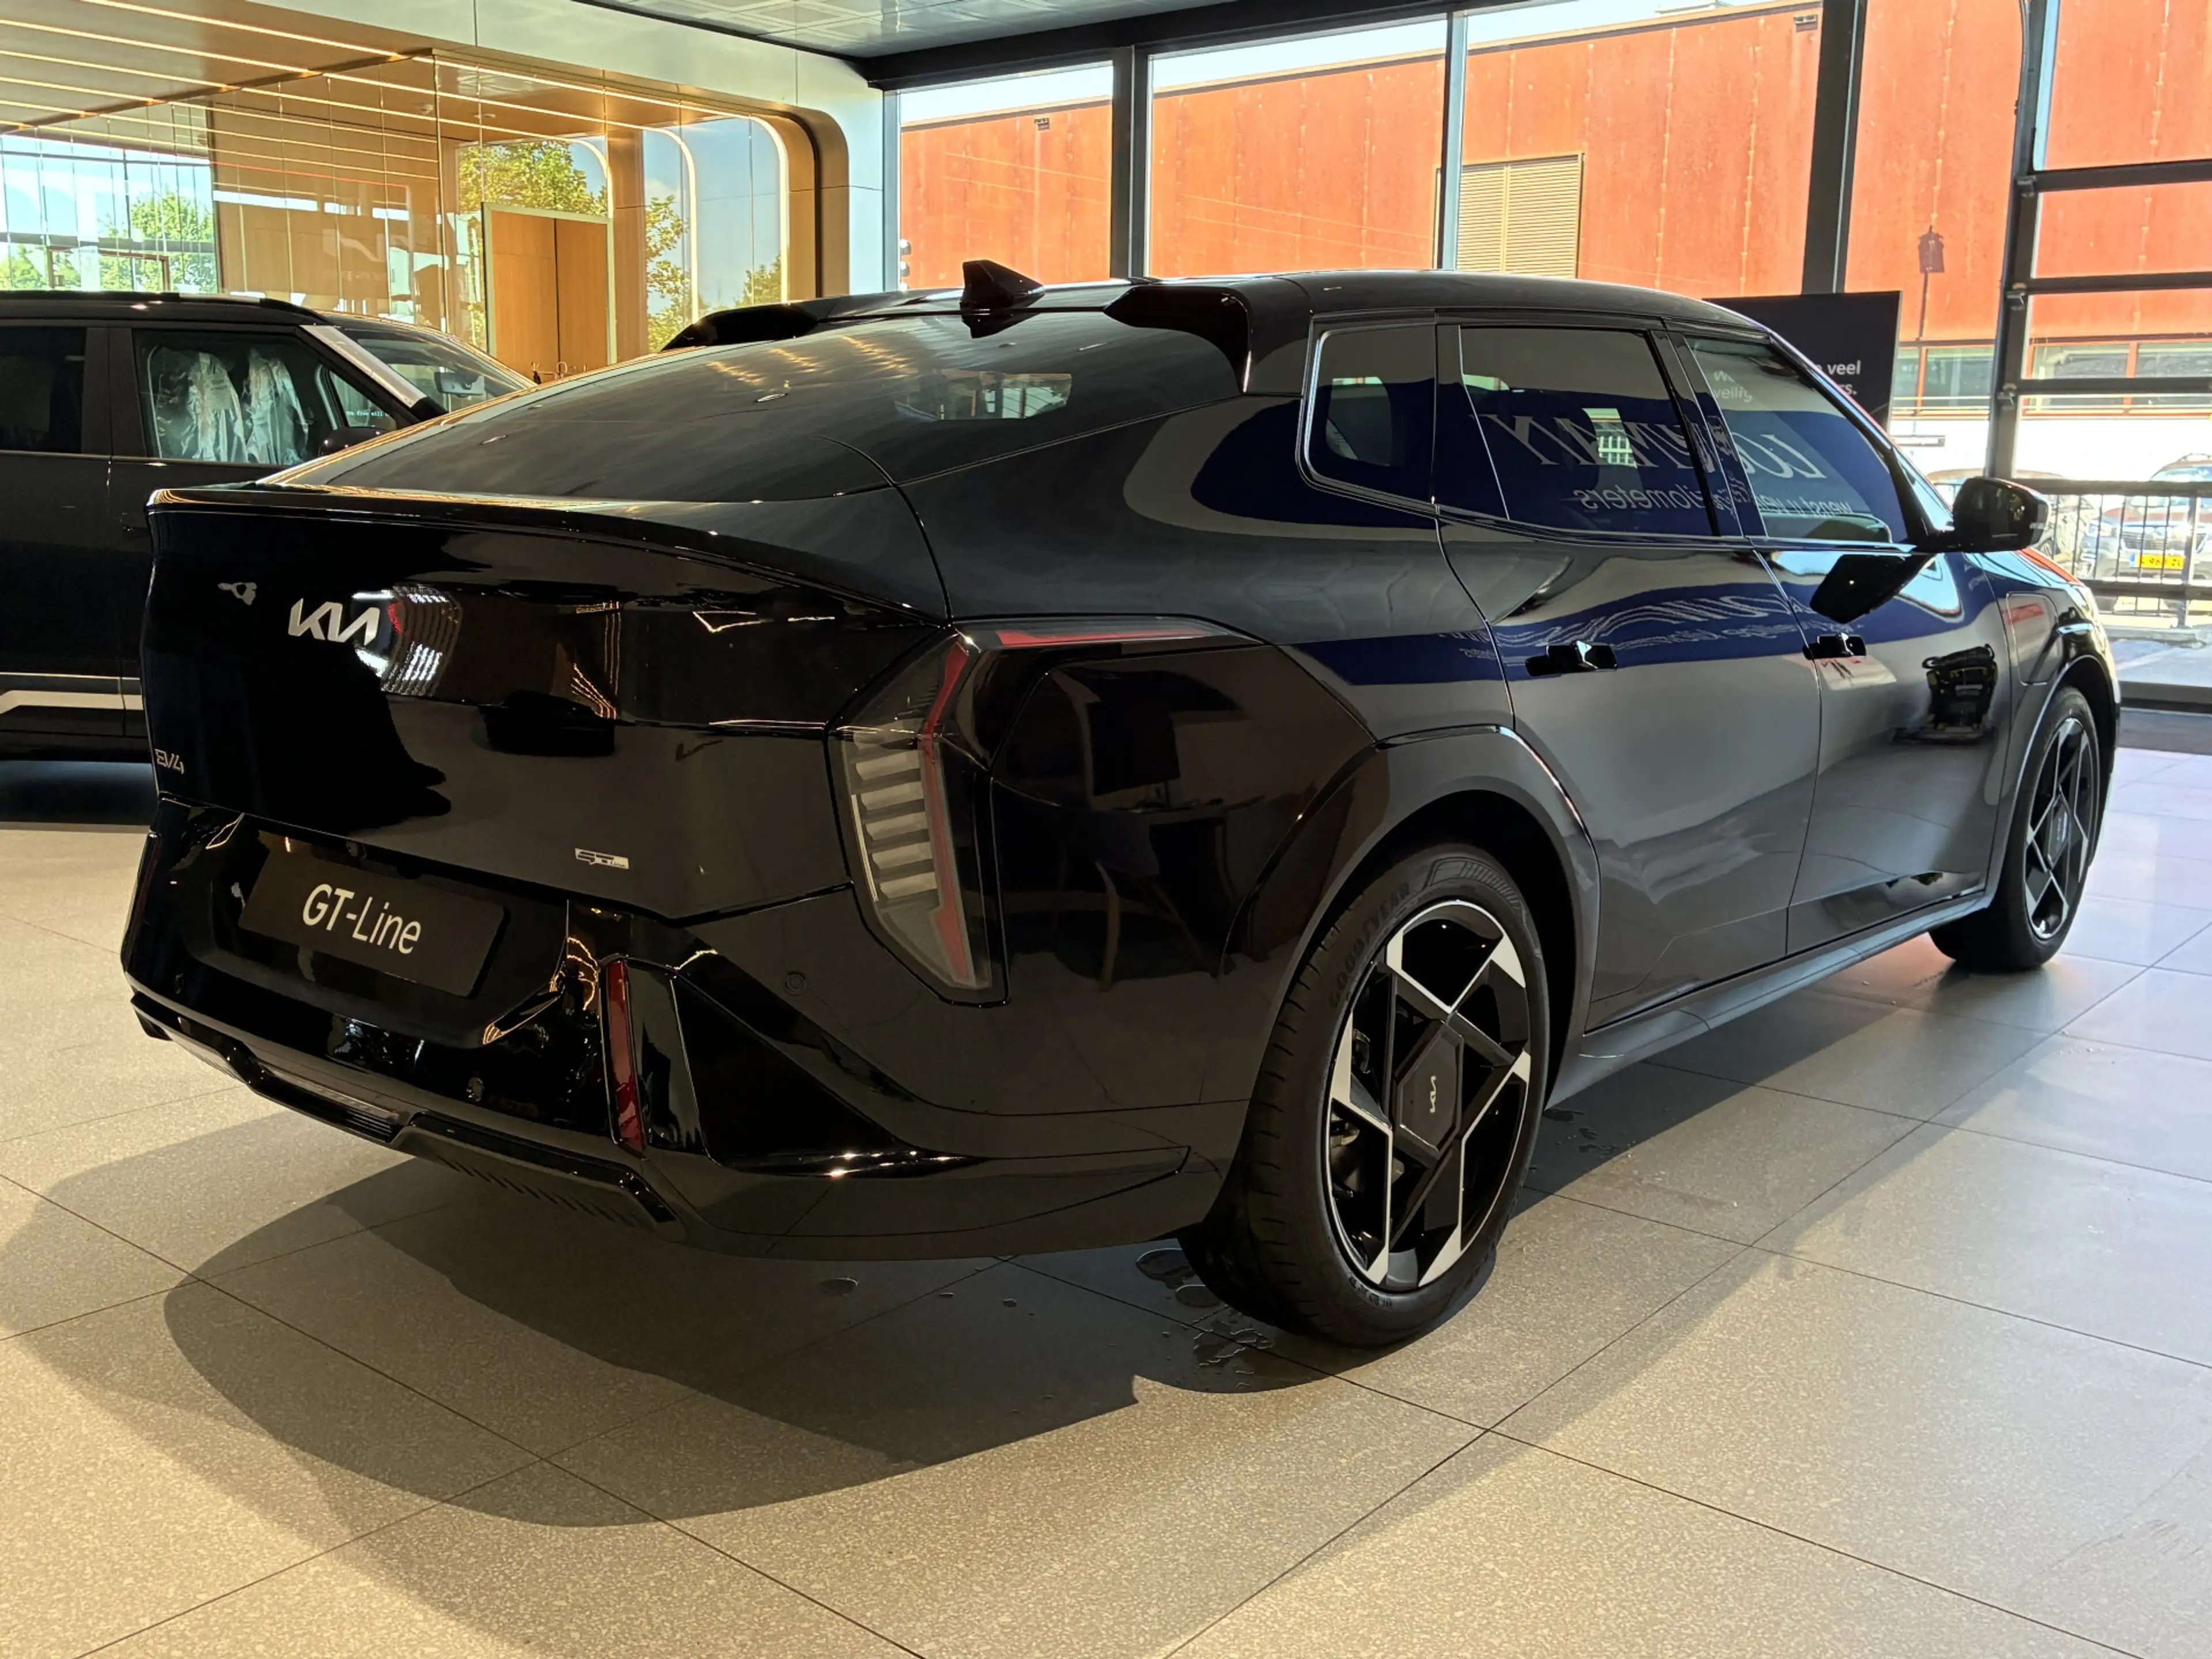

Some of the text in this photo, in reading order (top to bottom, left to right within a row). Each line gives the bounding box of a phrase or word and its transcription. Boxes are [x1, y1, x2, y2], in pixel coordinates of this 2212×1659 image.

[1827, 359, 1861, 375] veel
[288, 597, 380, 646] KIA
[154, 748, 184, 774] EV4
[302, 883, 422, 955] GT-Line
